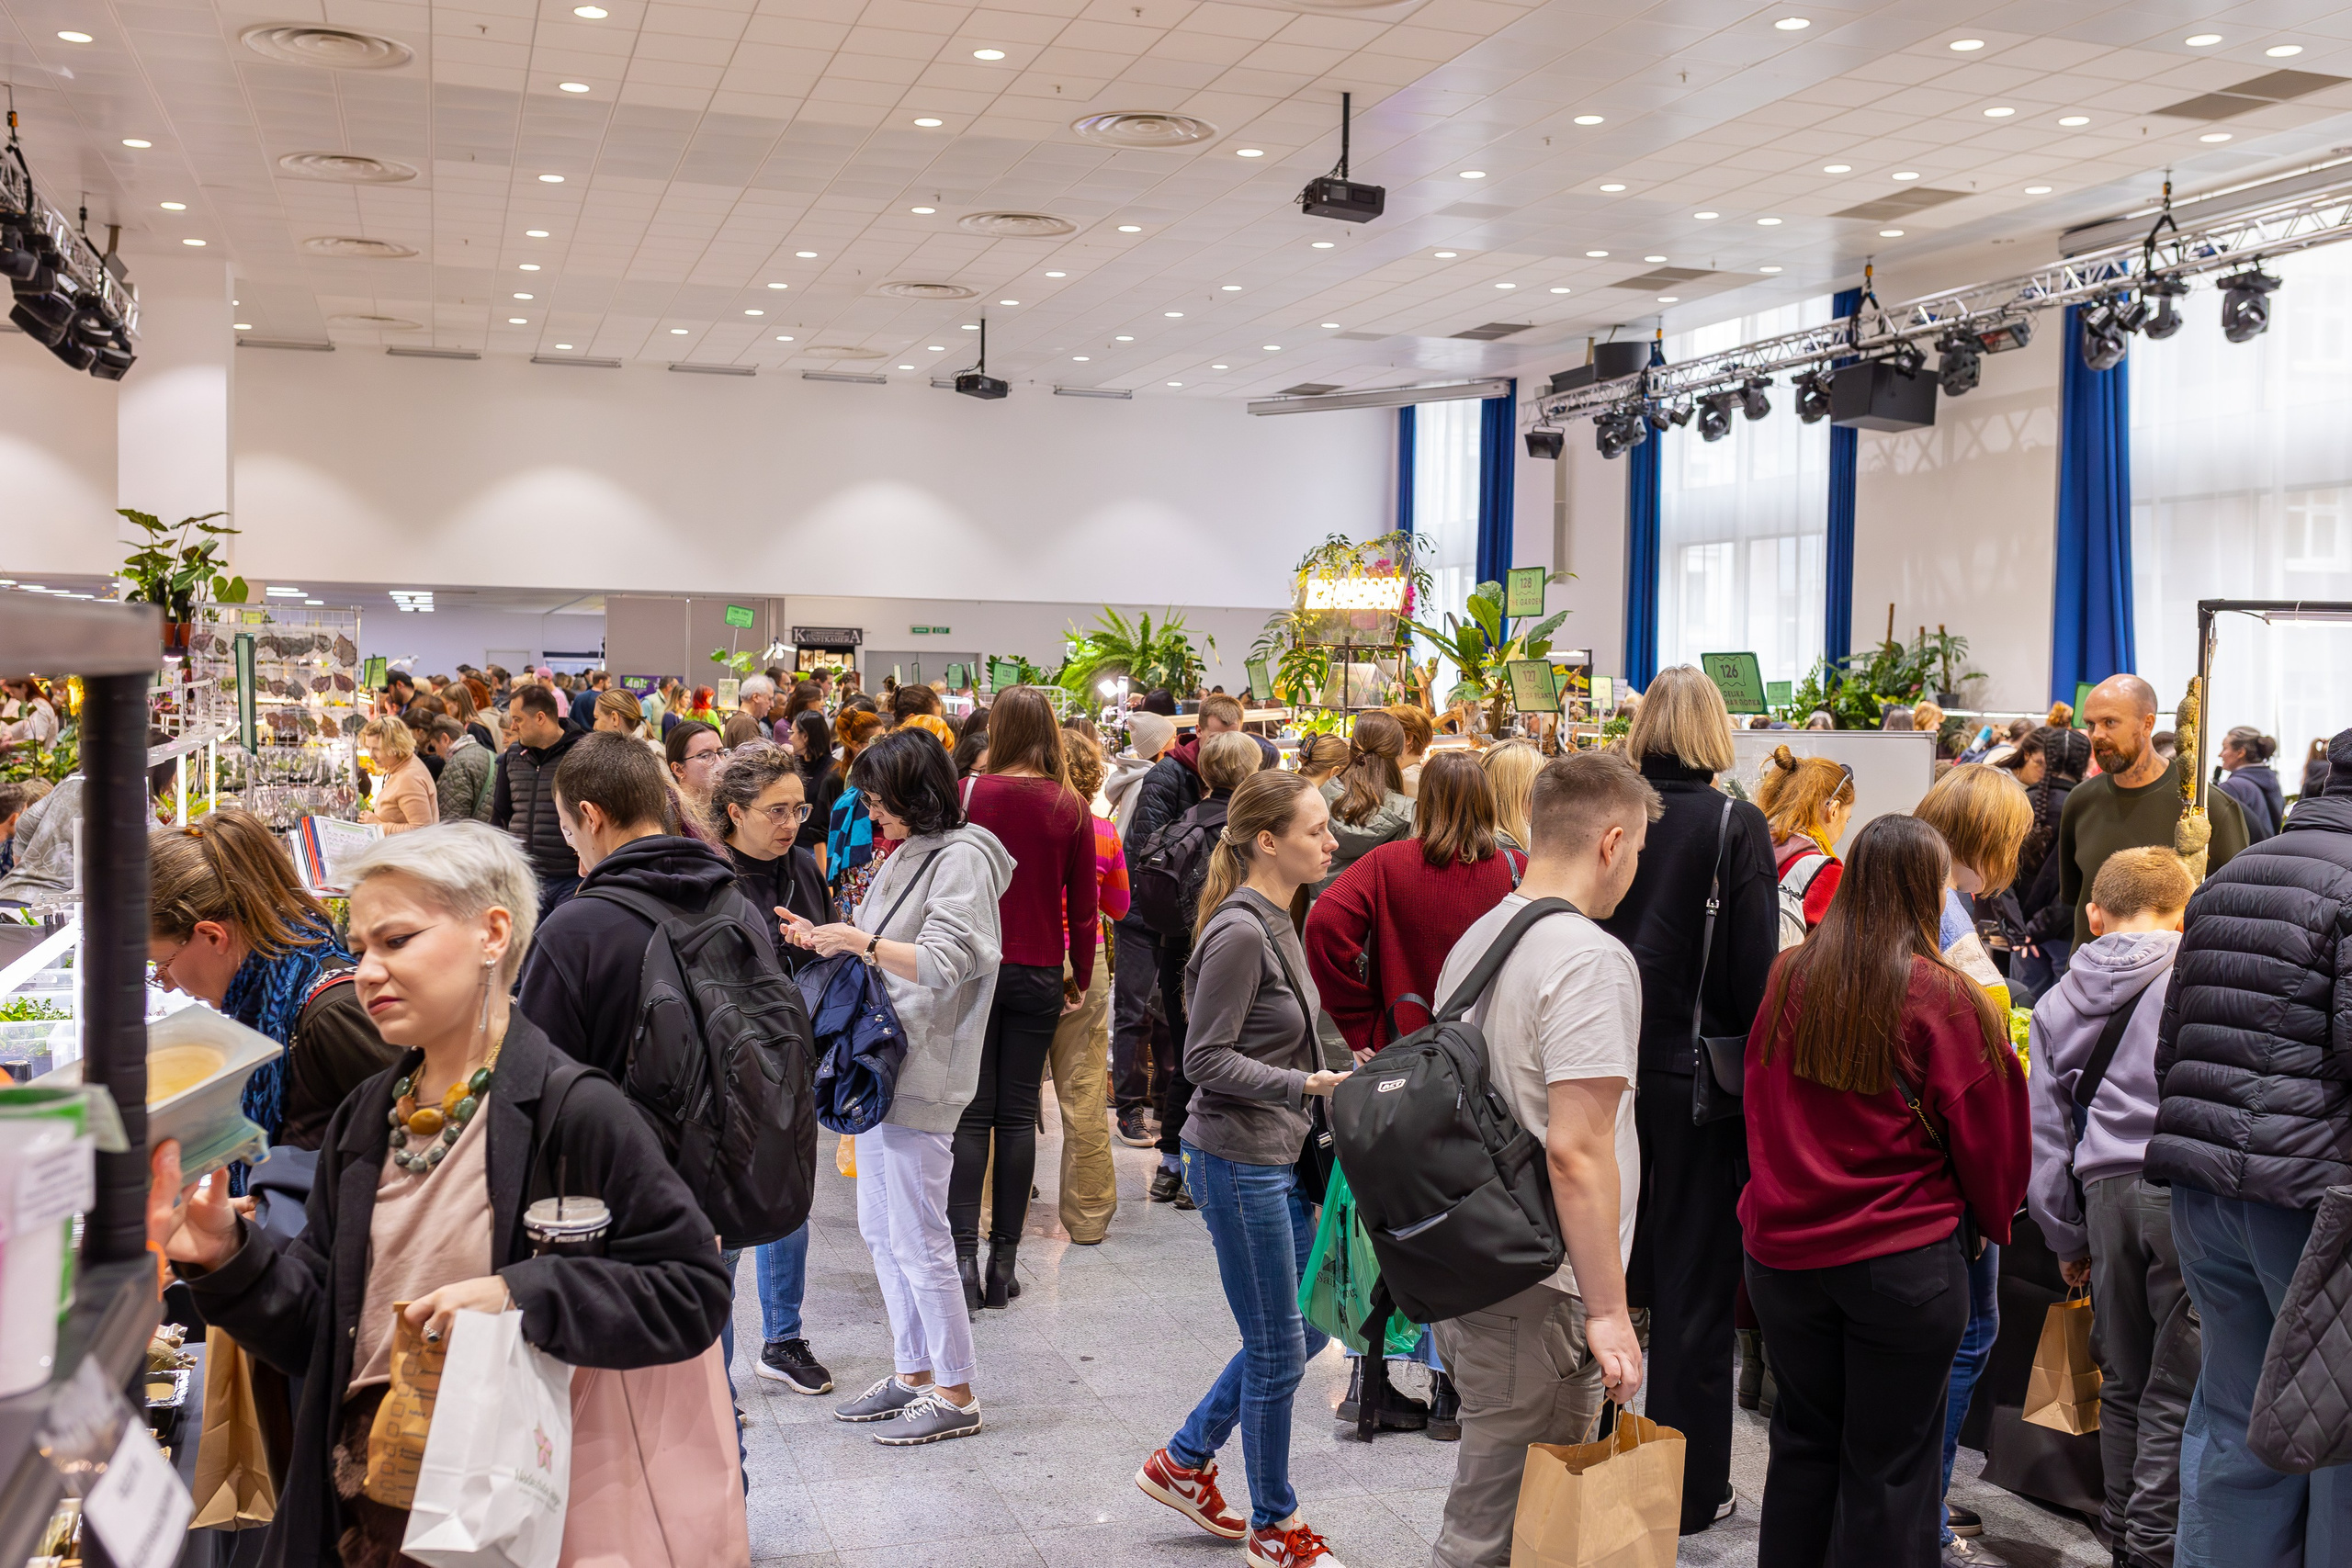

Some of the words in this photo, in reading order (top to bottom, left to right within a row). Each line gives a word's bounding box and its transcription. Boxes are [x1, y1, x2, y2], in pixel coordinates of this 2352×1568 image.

[1521, 578, 1532, 589] 128
[1522, 671, 1536, 682] 127
[1719, 664, 1738, 678] 126
